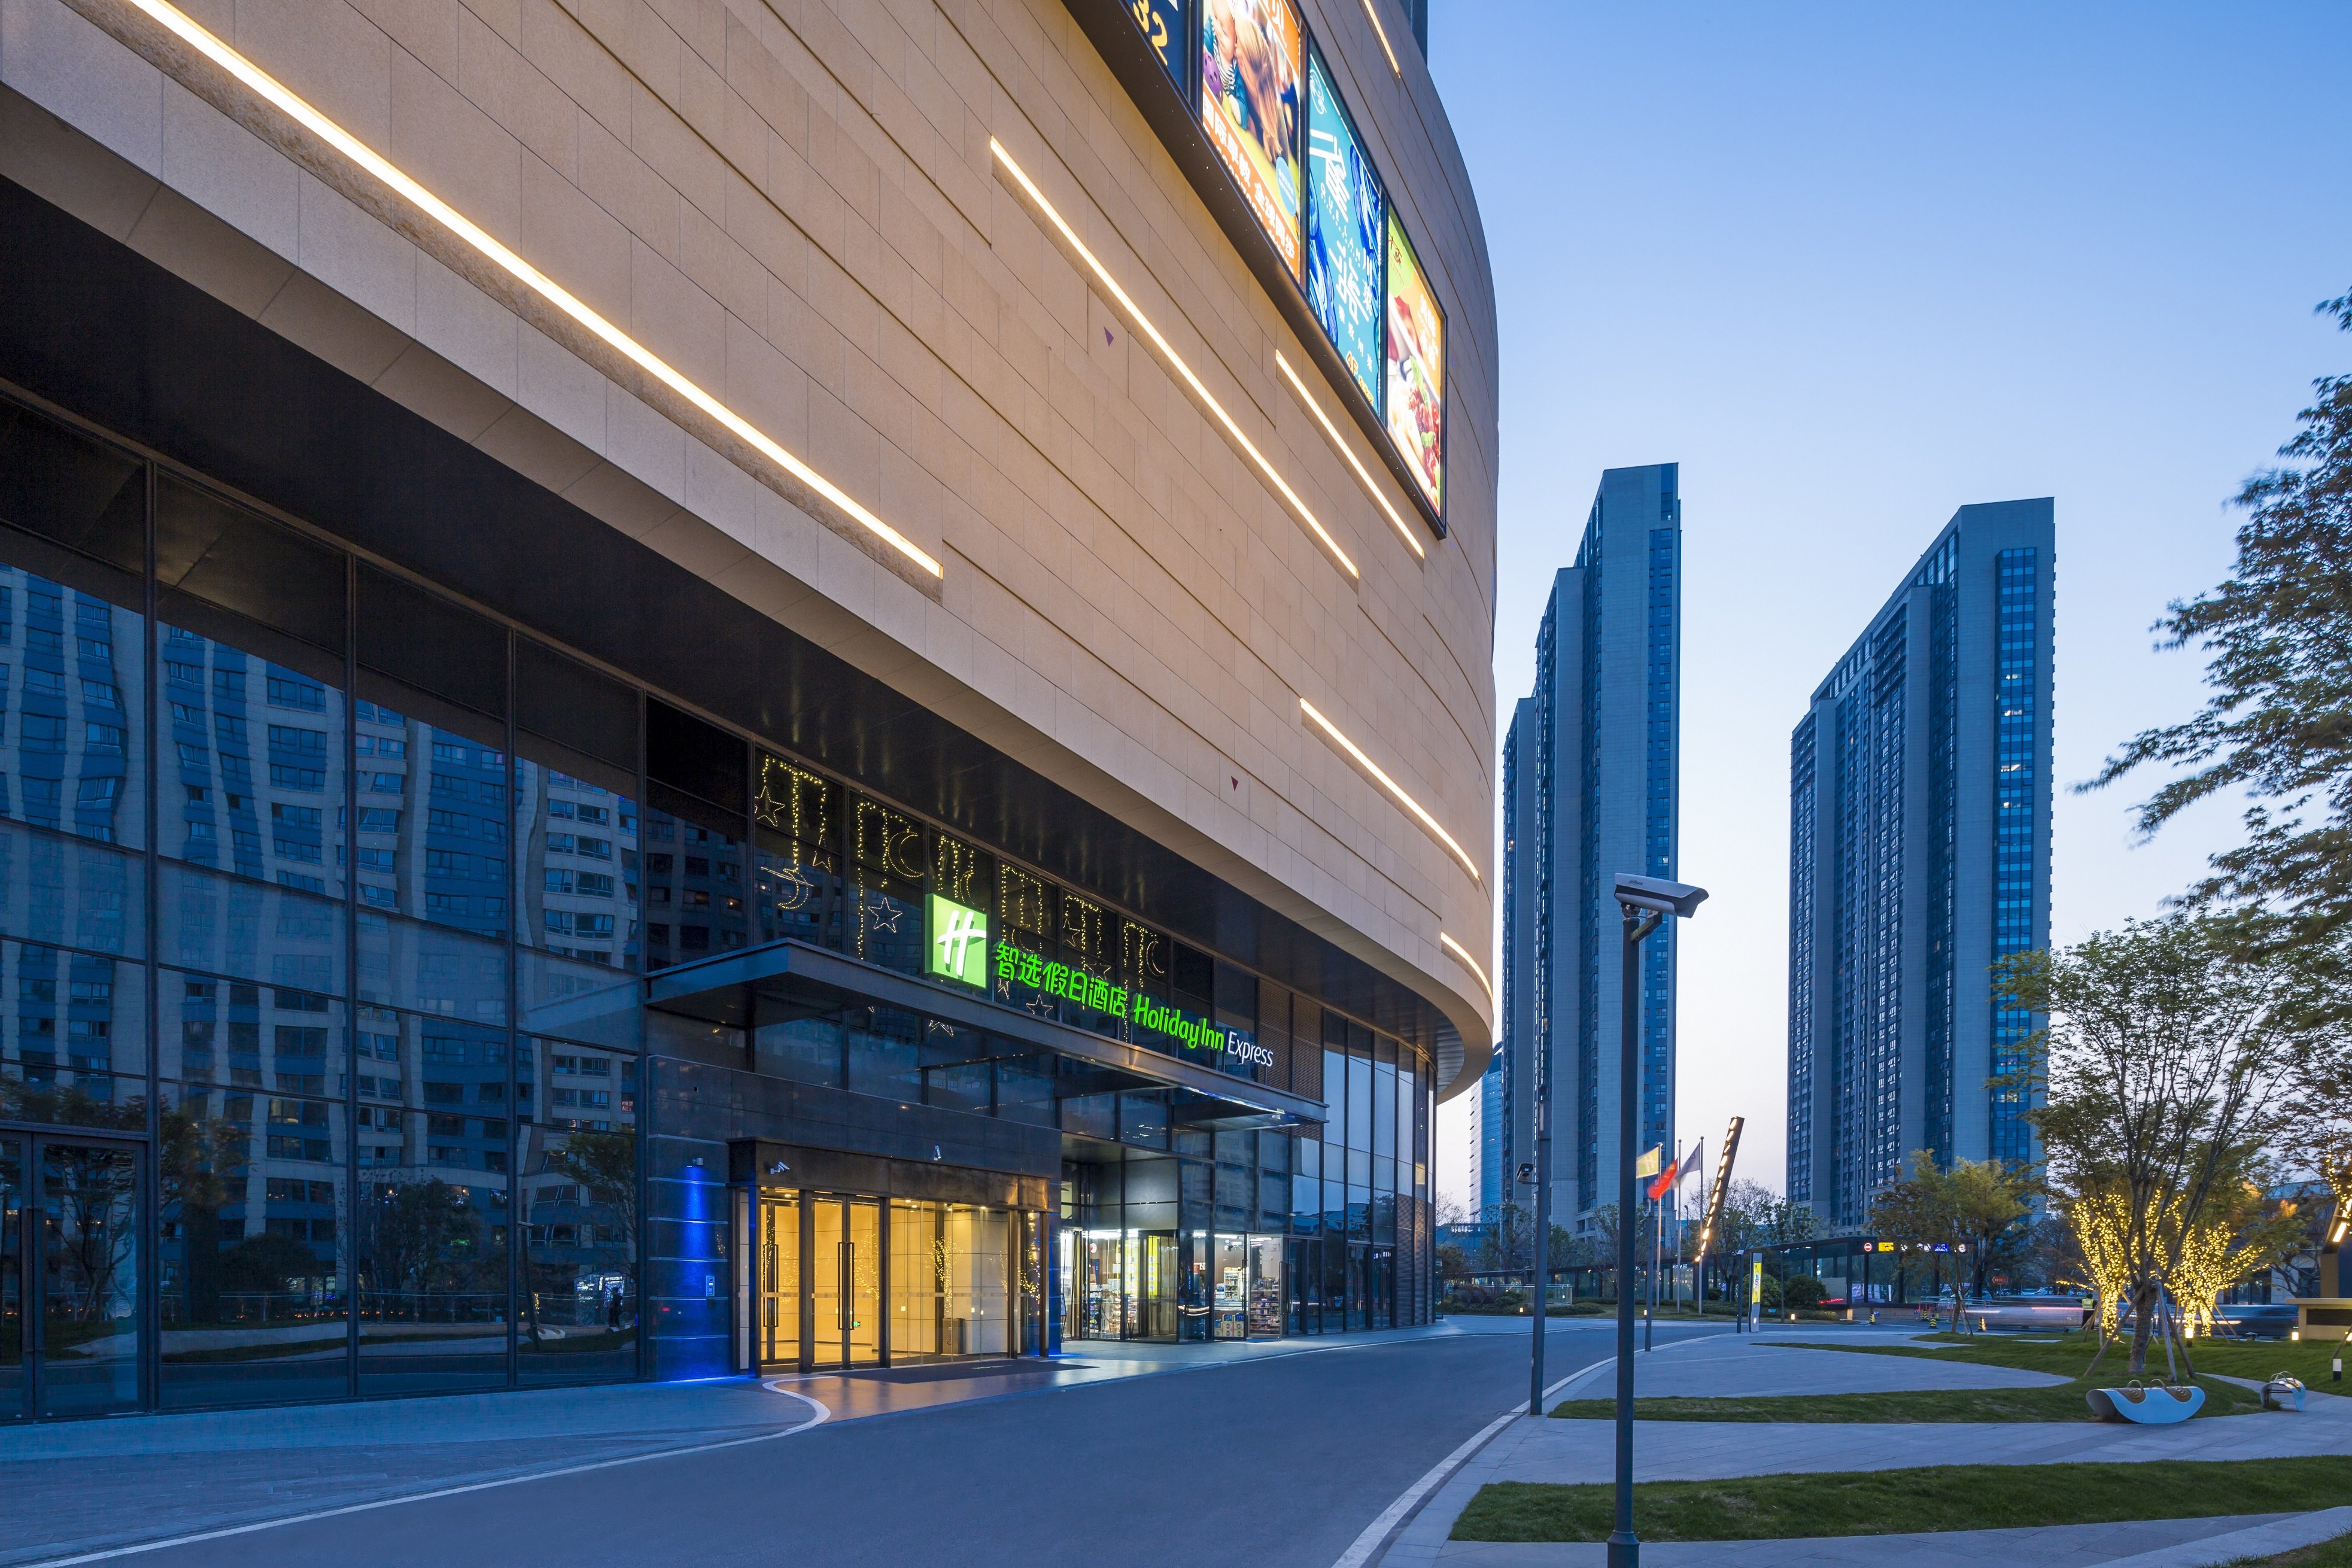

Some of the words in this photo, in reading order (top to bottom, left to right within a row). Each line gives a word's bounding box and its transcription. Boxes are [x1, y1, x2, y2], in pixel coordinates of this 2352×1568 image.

[996, 941, 1128, 1019] 智选假日酒店
[1134, 994, 1199, 1049] Holiday
[1201, 1018, 1224, 1051] Inn
[1227, 1031, 1273, 1067] Express
